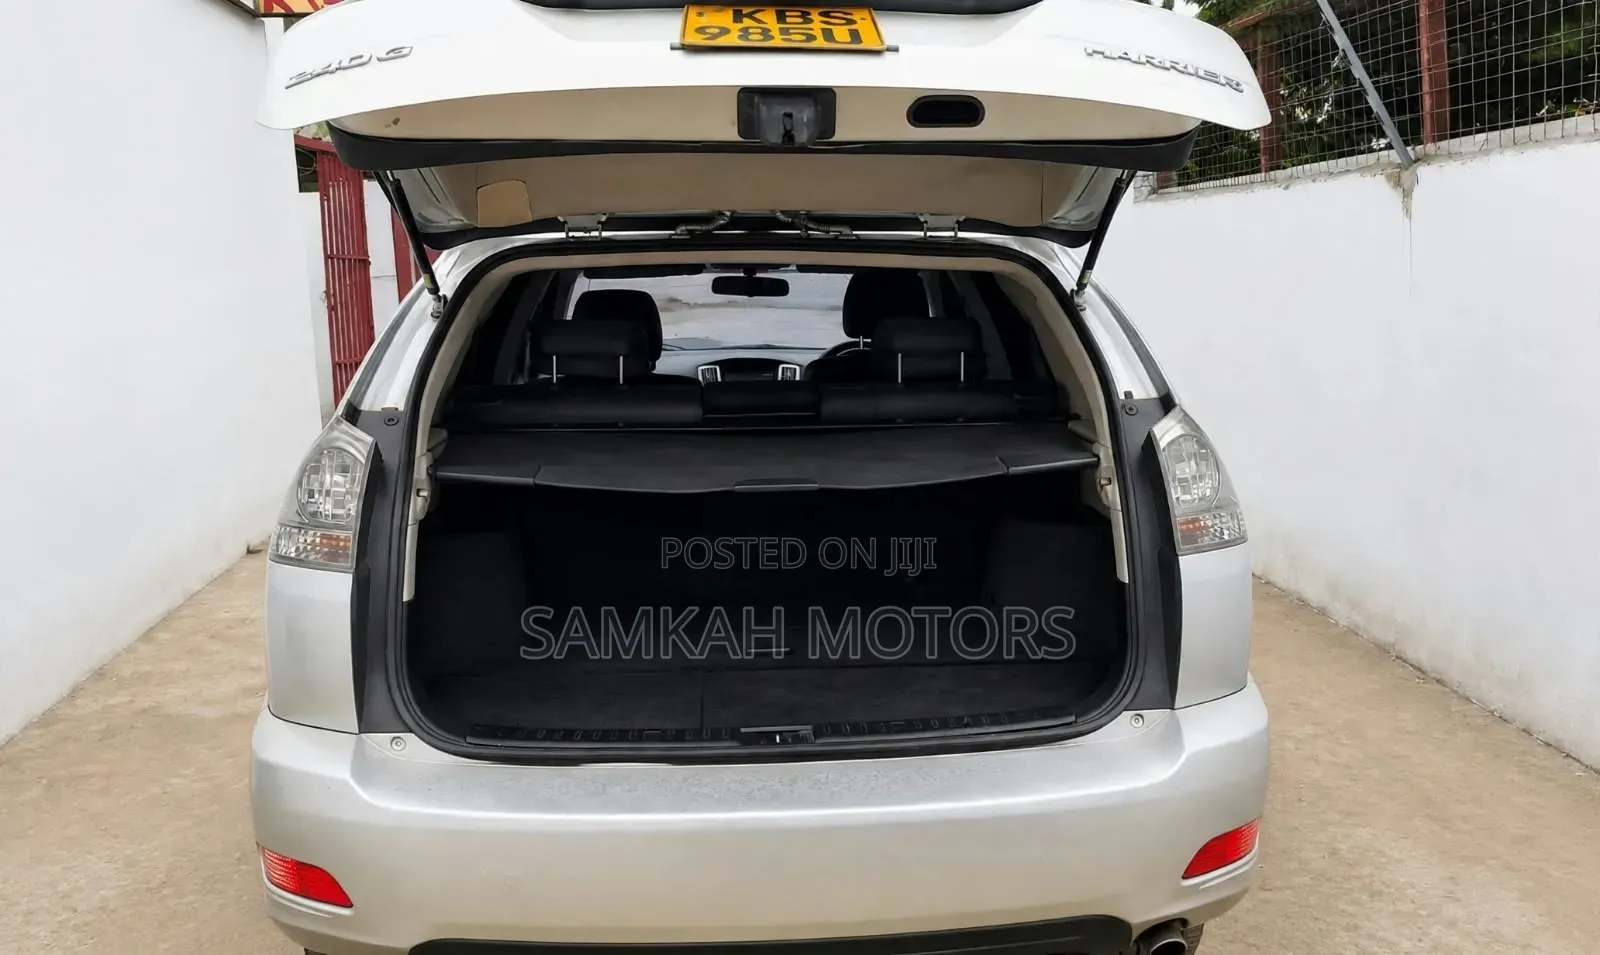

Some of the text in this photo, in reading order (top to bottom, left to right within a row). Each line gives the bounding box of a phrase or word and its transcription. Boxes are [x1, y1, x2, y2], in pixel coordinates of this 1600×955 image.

[731, 8, 858, 27] KBS
[694, 25, 864, 45] 985U
[1084, 46, 1245, 94] HARRIER
